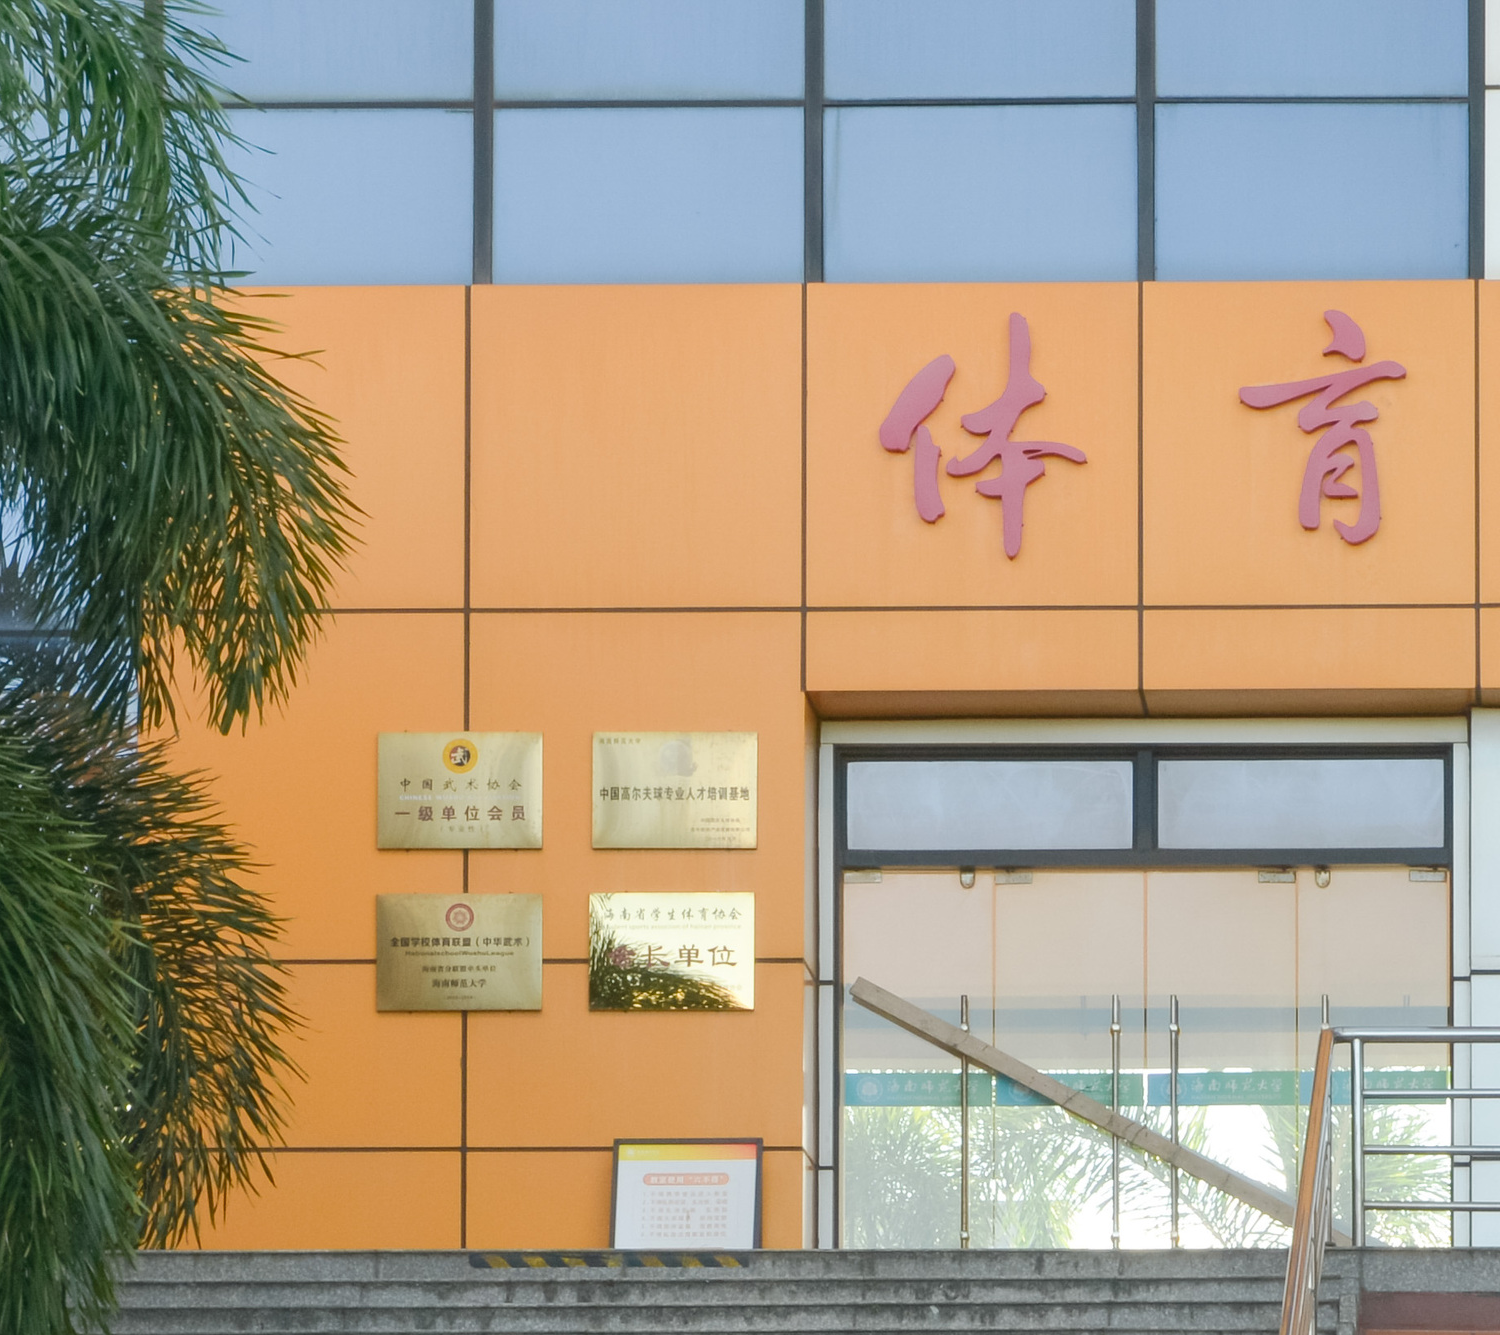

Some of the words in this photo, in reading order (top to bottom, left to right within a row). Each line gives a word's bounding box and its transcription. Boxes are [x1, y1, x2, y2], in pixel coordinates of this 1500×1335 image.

[400, 778, 522, 792] 中国武术协会
[599, 786, 750, 801] 中国高尔夫球专业人才培训基地
[395, 805, 525, 821] 一级单位会员
[604, 907, 742, 921] 海南省学生体育协会
[432, 979, 487, 988] 海南师范大学
[1190, 1077, 1282, 1093] 海南师范大学
